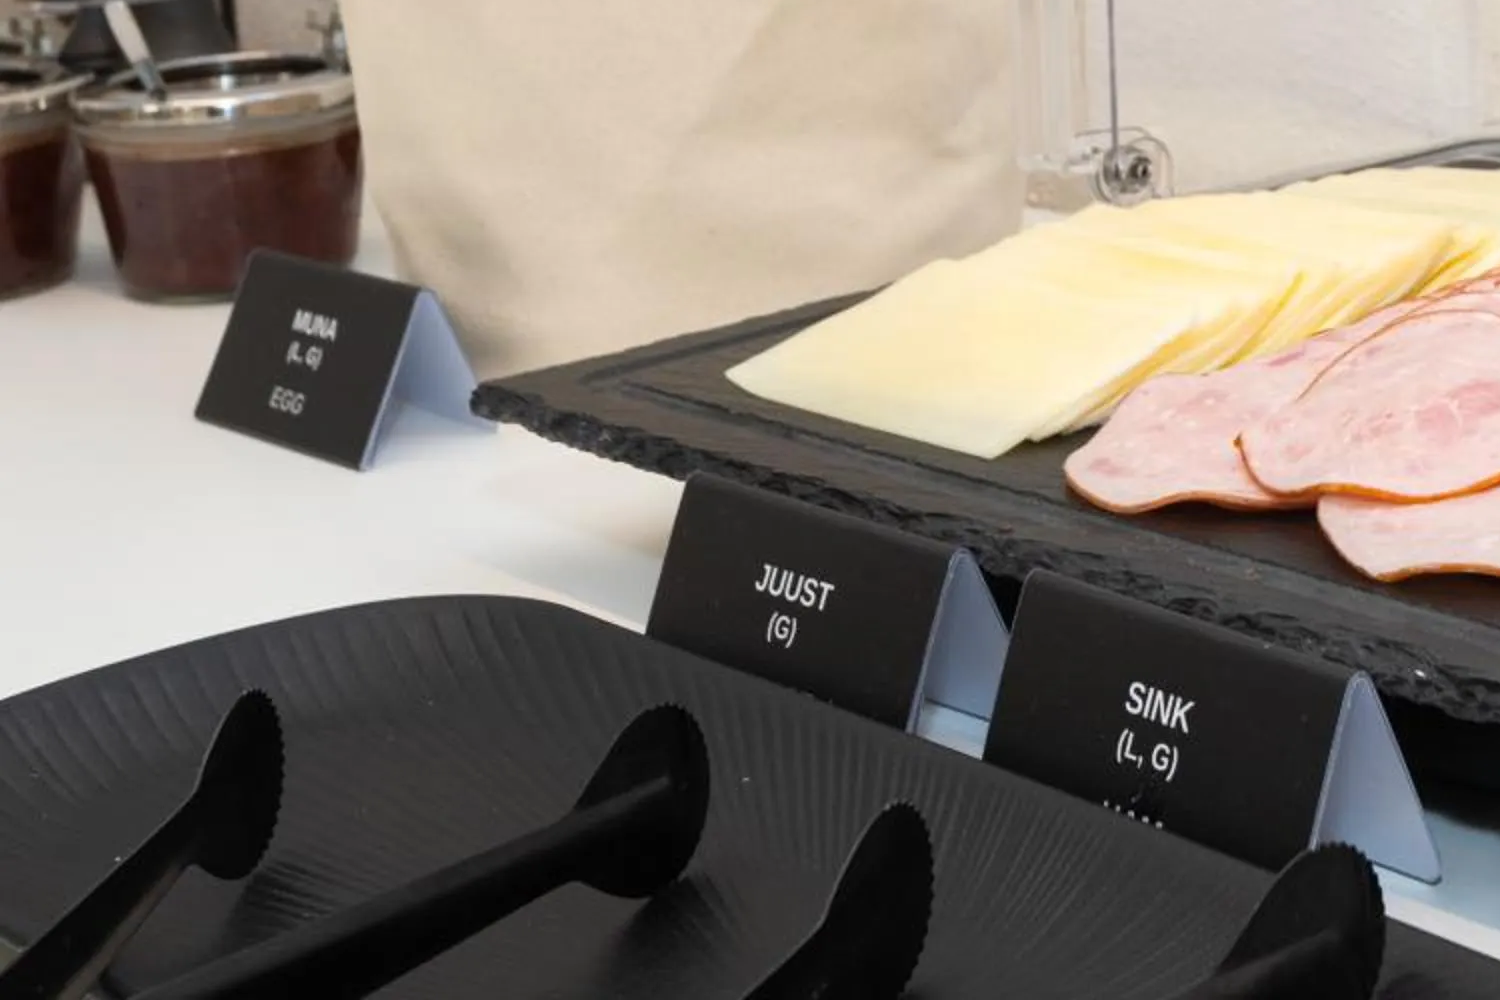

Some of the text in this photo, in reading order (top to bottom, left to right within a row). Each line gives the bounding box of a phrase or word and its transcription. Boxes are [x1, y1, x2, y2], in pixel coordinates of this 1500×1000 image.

[292, 308, 338, 341] MUNA
[269, 385, 306, 415] EGG
[755, 563, 835, 610] JUUST
[766, 611, 797, 649] (G)
[1125, 681, 1195, 734] SINK
[1117, 728, 1179, 782] (L, G)
